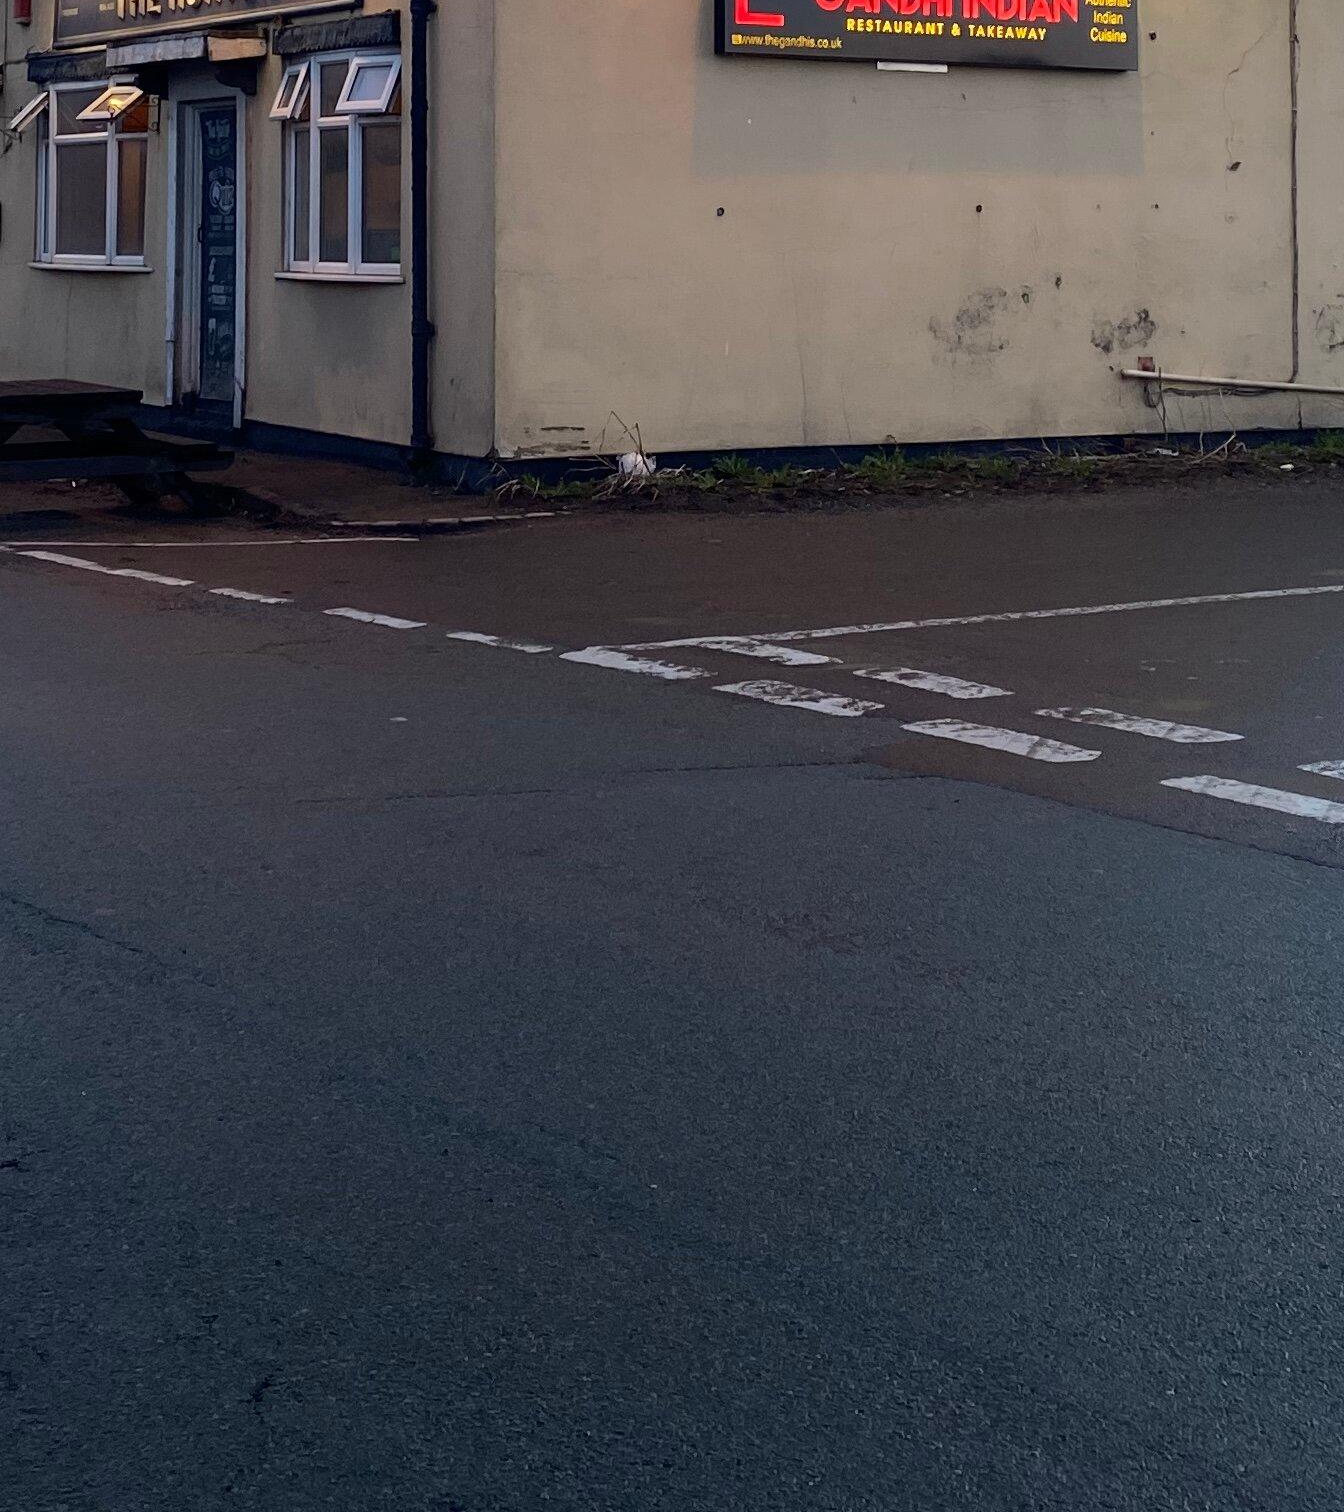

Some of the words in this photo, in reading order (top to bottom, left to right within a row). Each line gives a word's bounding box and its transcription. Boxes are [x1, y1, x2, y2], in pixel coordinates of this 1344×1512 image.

[1093, 9, 1124, 25] Indian
[846, 18, 944, 36] RESTAURANT
[951, 23, 961, 37] &
[968, 24, 1046, 41] TAKEAWAY
[1089, 26, 1127, 43] Cuisine
